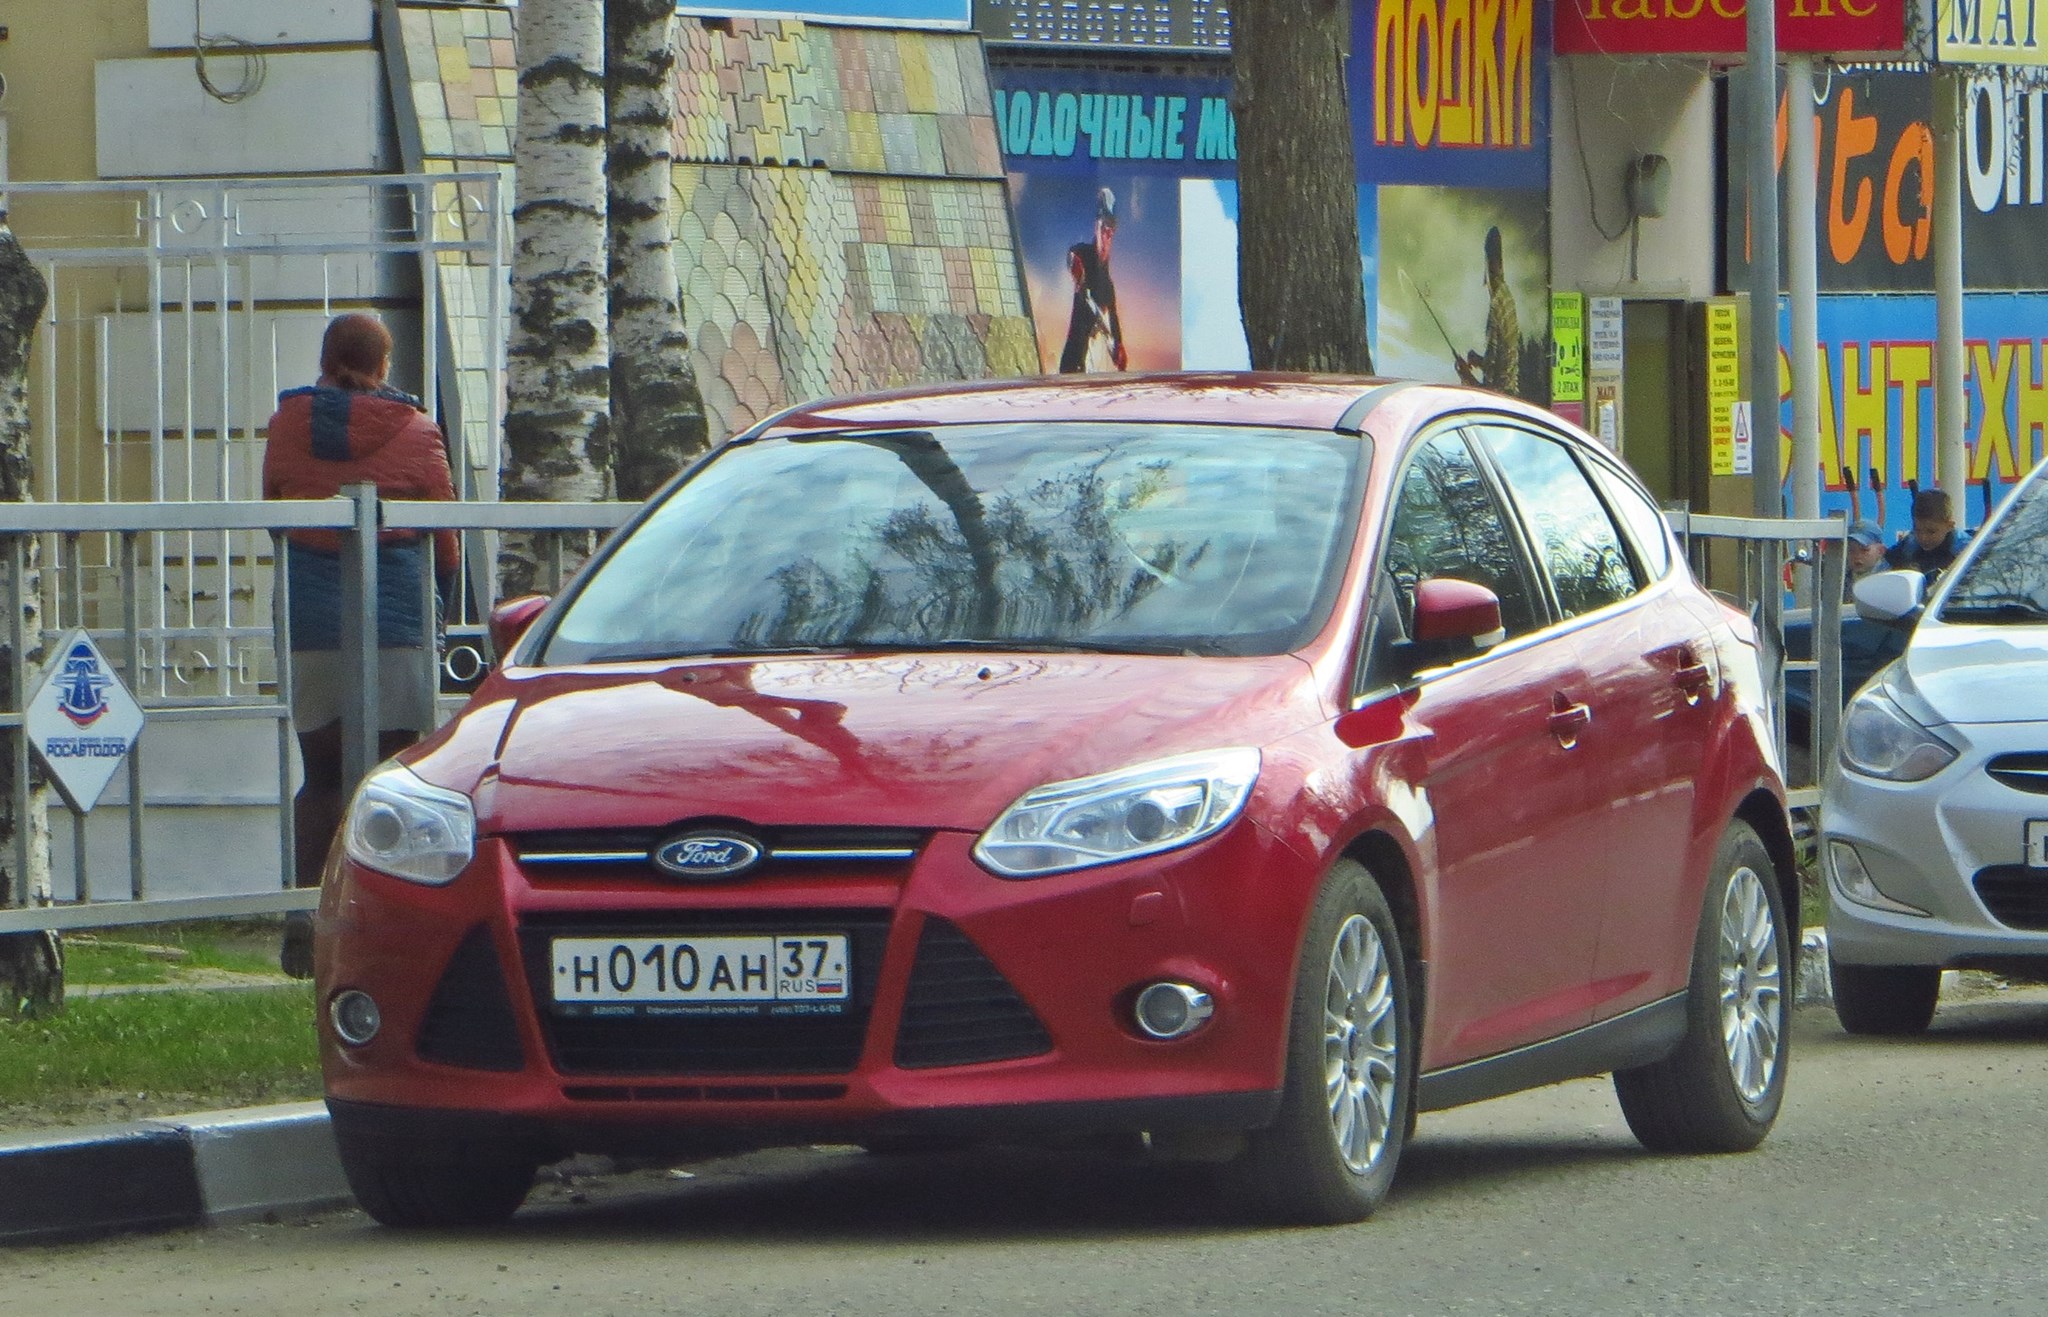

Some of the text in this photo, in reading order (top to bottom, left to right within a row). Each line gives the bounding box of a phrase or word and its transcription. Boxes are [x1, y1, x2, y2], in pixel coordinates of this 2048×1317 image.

[1965, 66, 2048, 213] ОП
[46, 744, 126, 757] РОСАВТОДОР
[676, 841, 733, 865] Ford
[573, 941, 829, 993] Н010АН 37
[779, 980, 815, 993] RUS
